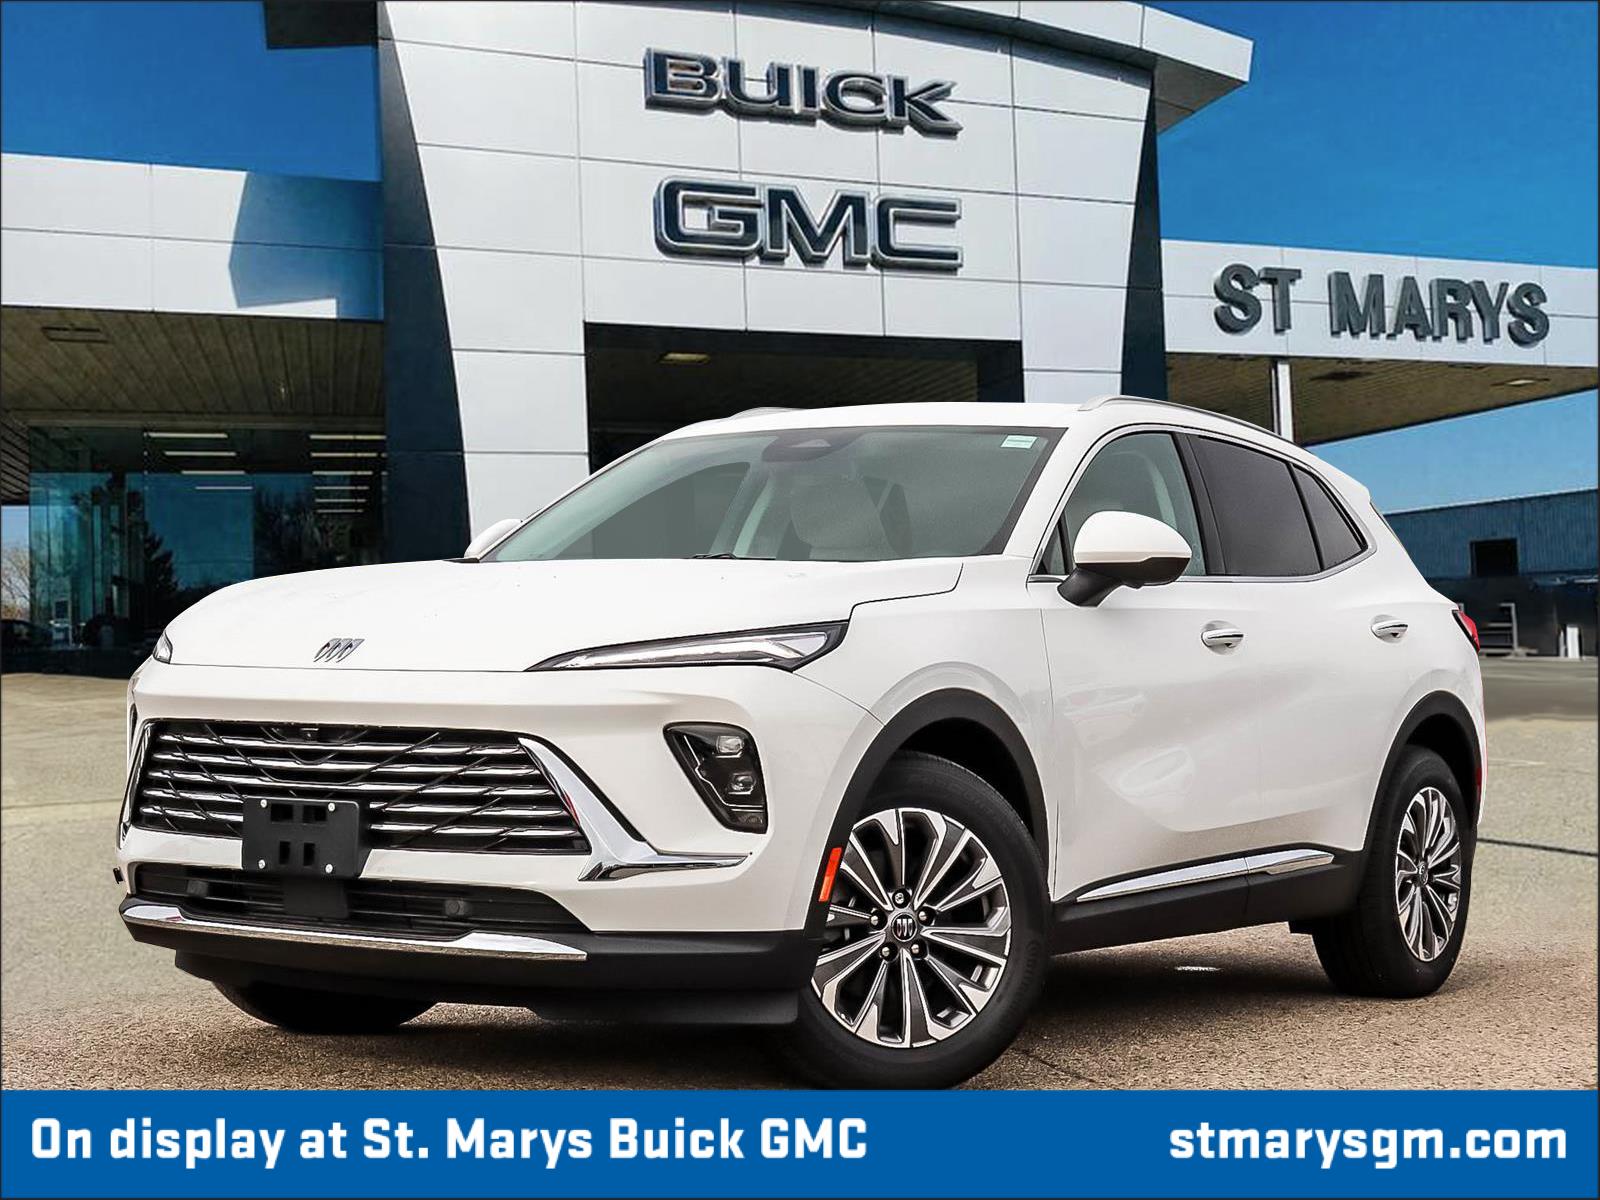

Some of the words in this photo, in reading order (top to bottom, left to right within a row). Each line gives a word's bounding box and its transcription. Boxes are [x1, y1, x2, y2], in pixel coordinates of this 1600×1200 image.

[643, 48, 963, 139] BUICK
[653, 175, 963, 275] GMC
[1214, 263, 1302, 335] ST
[1327, 271, 1550, 347] MARYS
